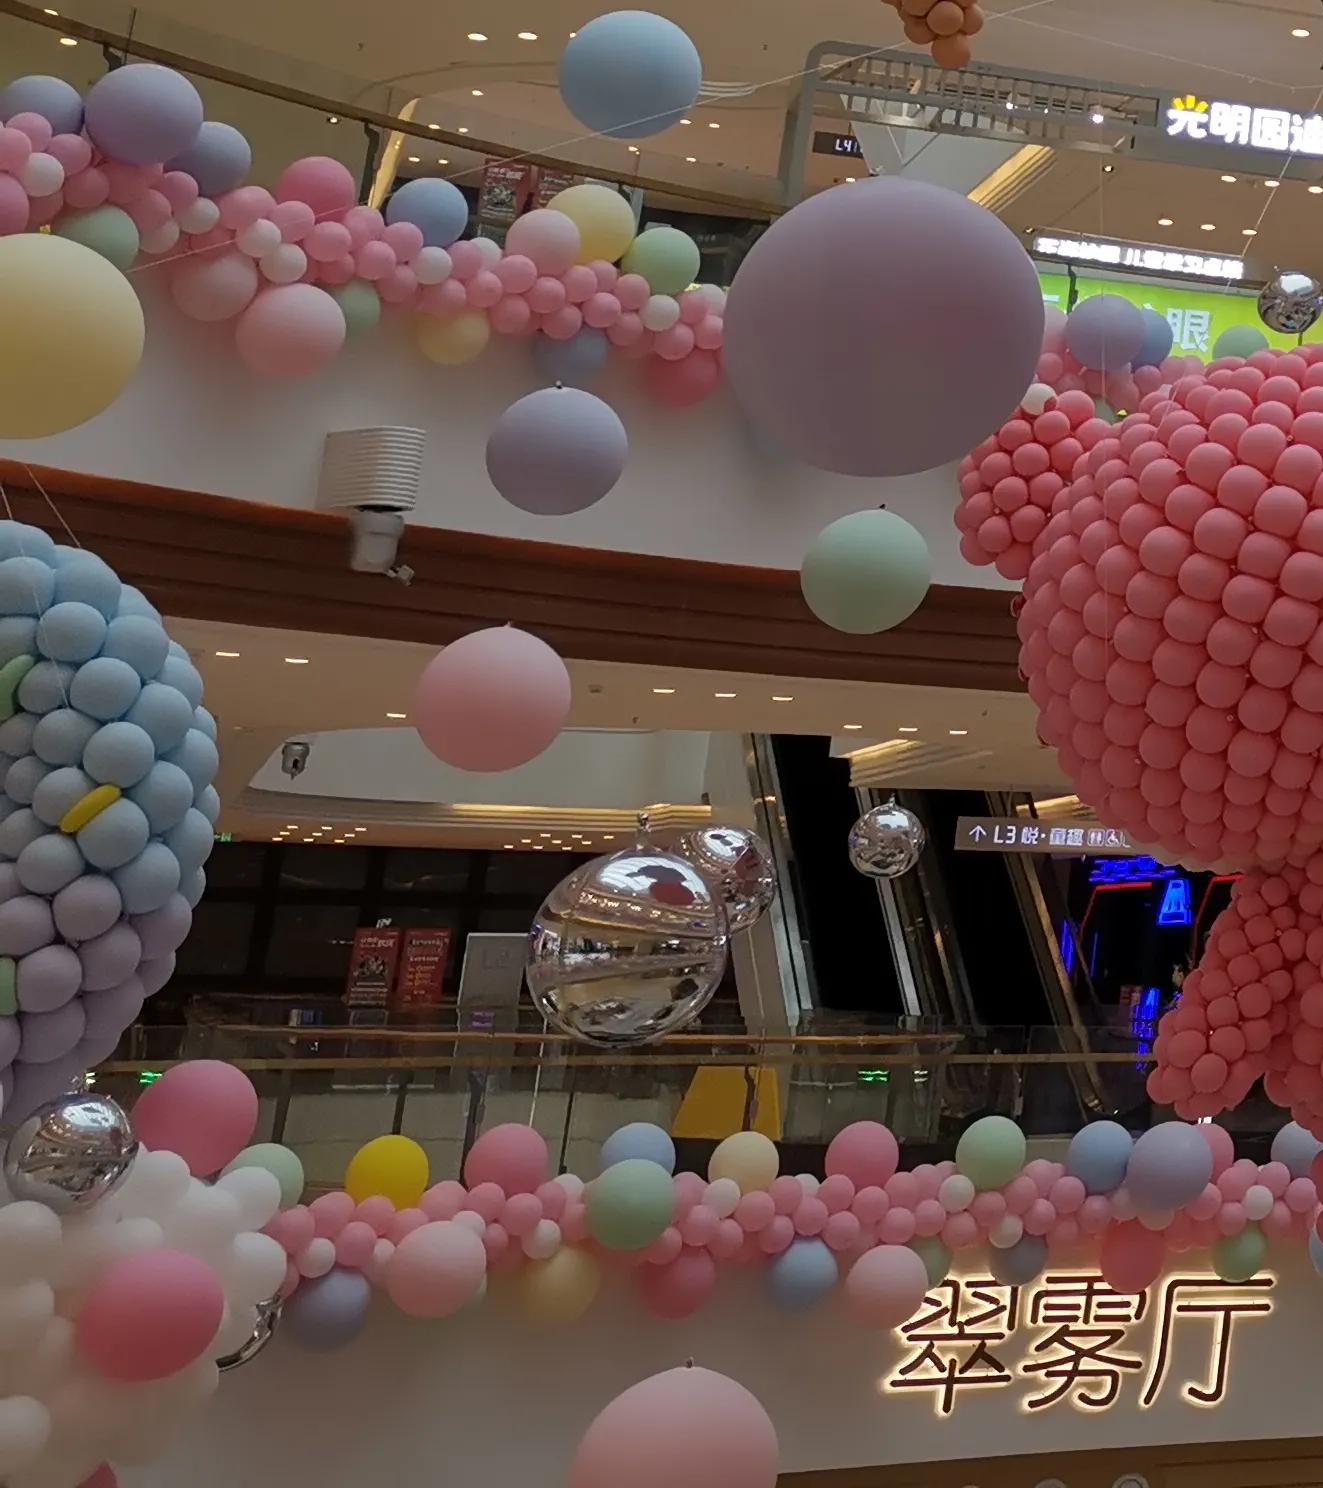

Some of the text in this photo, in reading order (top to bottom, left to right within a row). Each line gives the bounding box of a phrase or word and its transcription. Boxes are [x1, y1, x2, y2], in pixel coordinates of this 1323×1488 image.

[993, 825, 1016, 845] L3
[888, 1274, 1275, 1414] 翠雾厅
